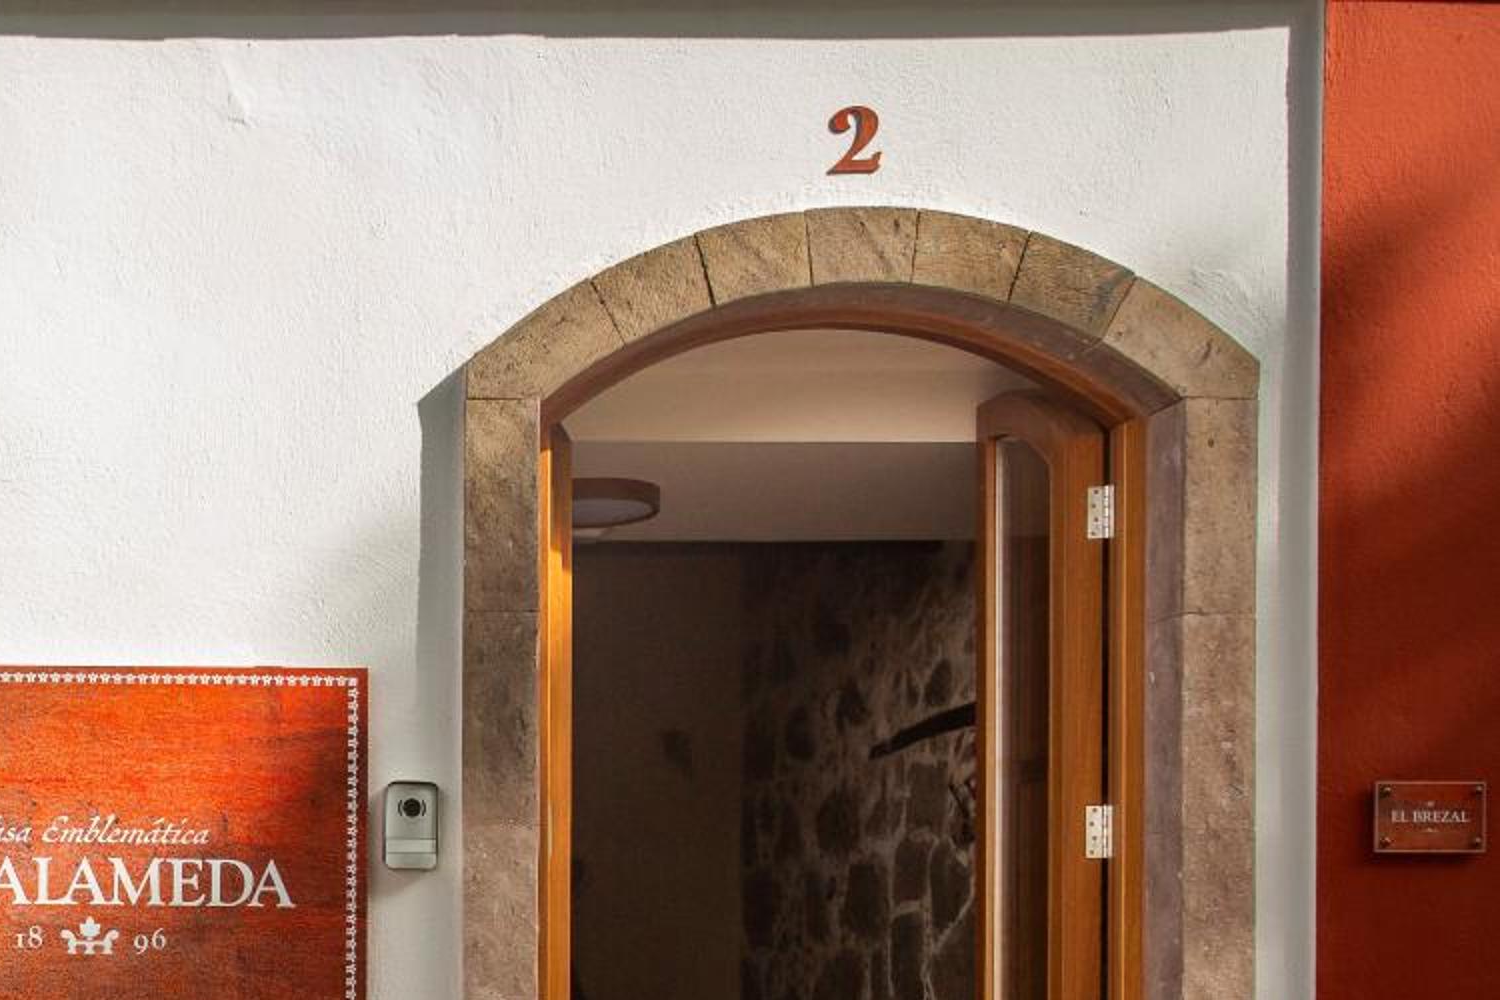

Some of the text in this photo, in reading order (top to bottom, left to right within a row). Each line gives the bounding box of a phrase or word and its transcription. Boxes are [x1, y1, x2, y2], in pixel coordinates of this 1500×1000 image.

[825, 105, 882, 176] 2
[42, 813, 210, 845] Emblemática
[1391, 810, 1470, 823] EL BREZAL
[14, 927, 167, 955] 18 96
